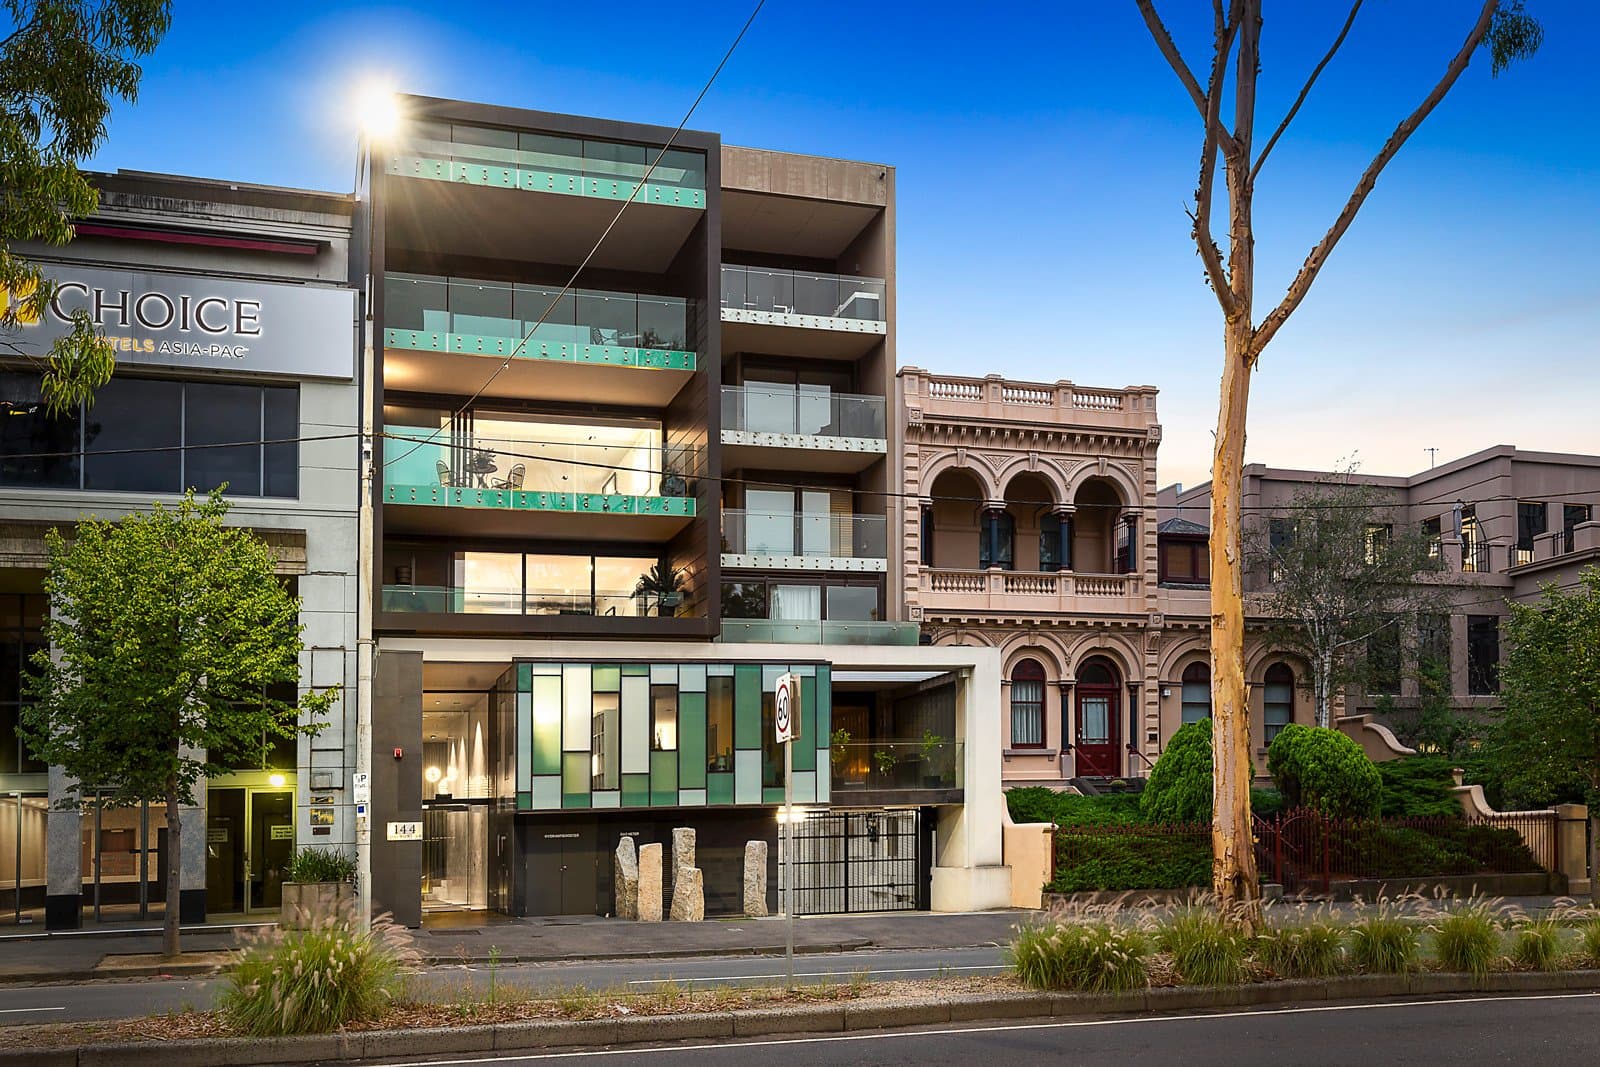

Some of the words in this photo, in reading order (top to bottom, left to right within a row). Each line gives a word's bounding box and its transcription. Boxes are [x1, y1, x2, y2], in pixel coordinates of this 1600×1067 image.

[52, 283, 261, 336] CHOICE
[159, 342, 244, 358] ASIA-PAC
[778, 697, 788, 720] 60
[393, 823, 416, 835] 144
